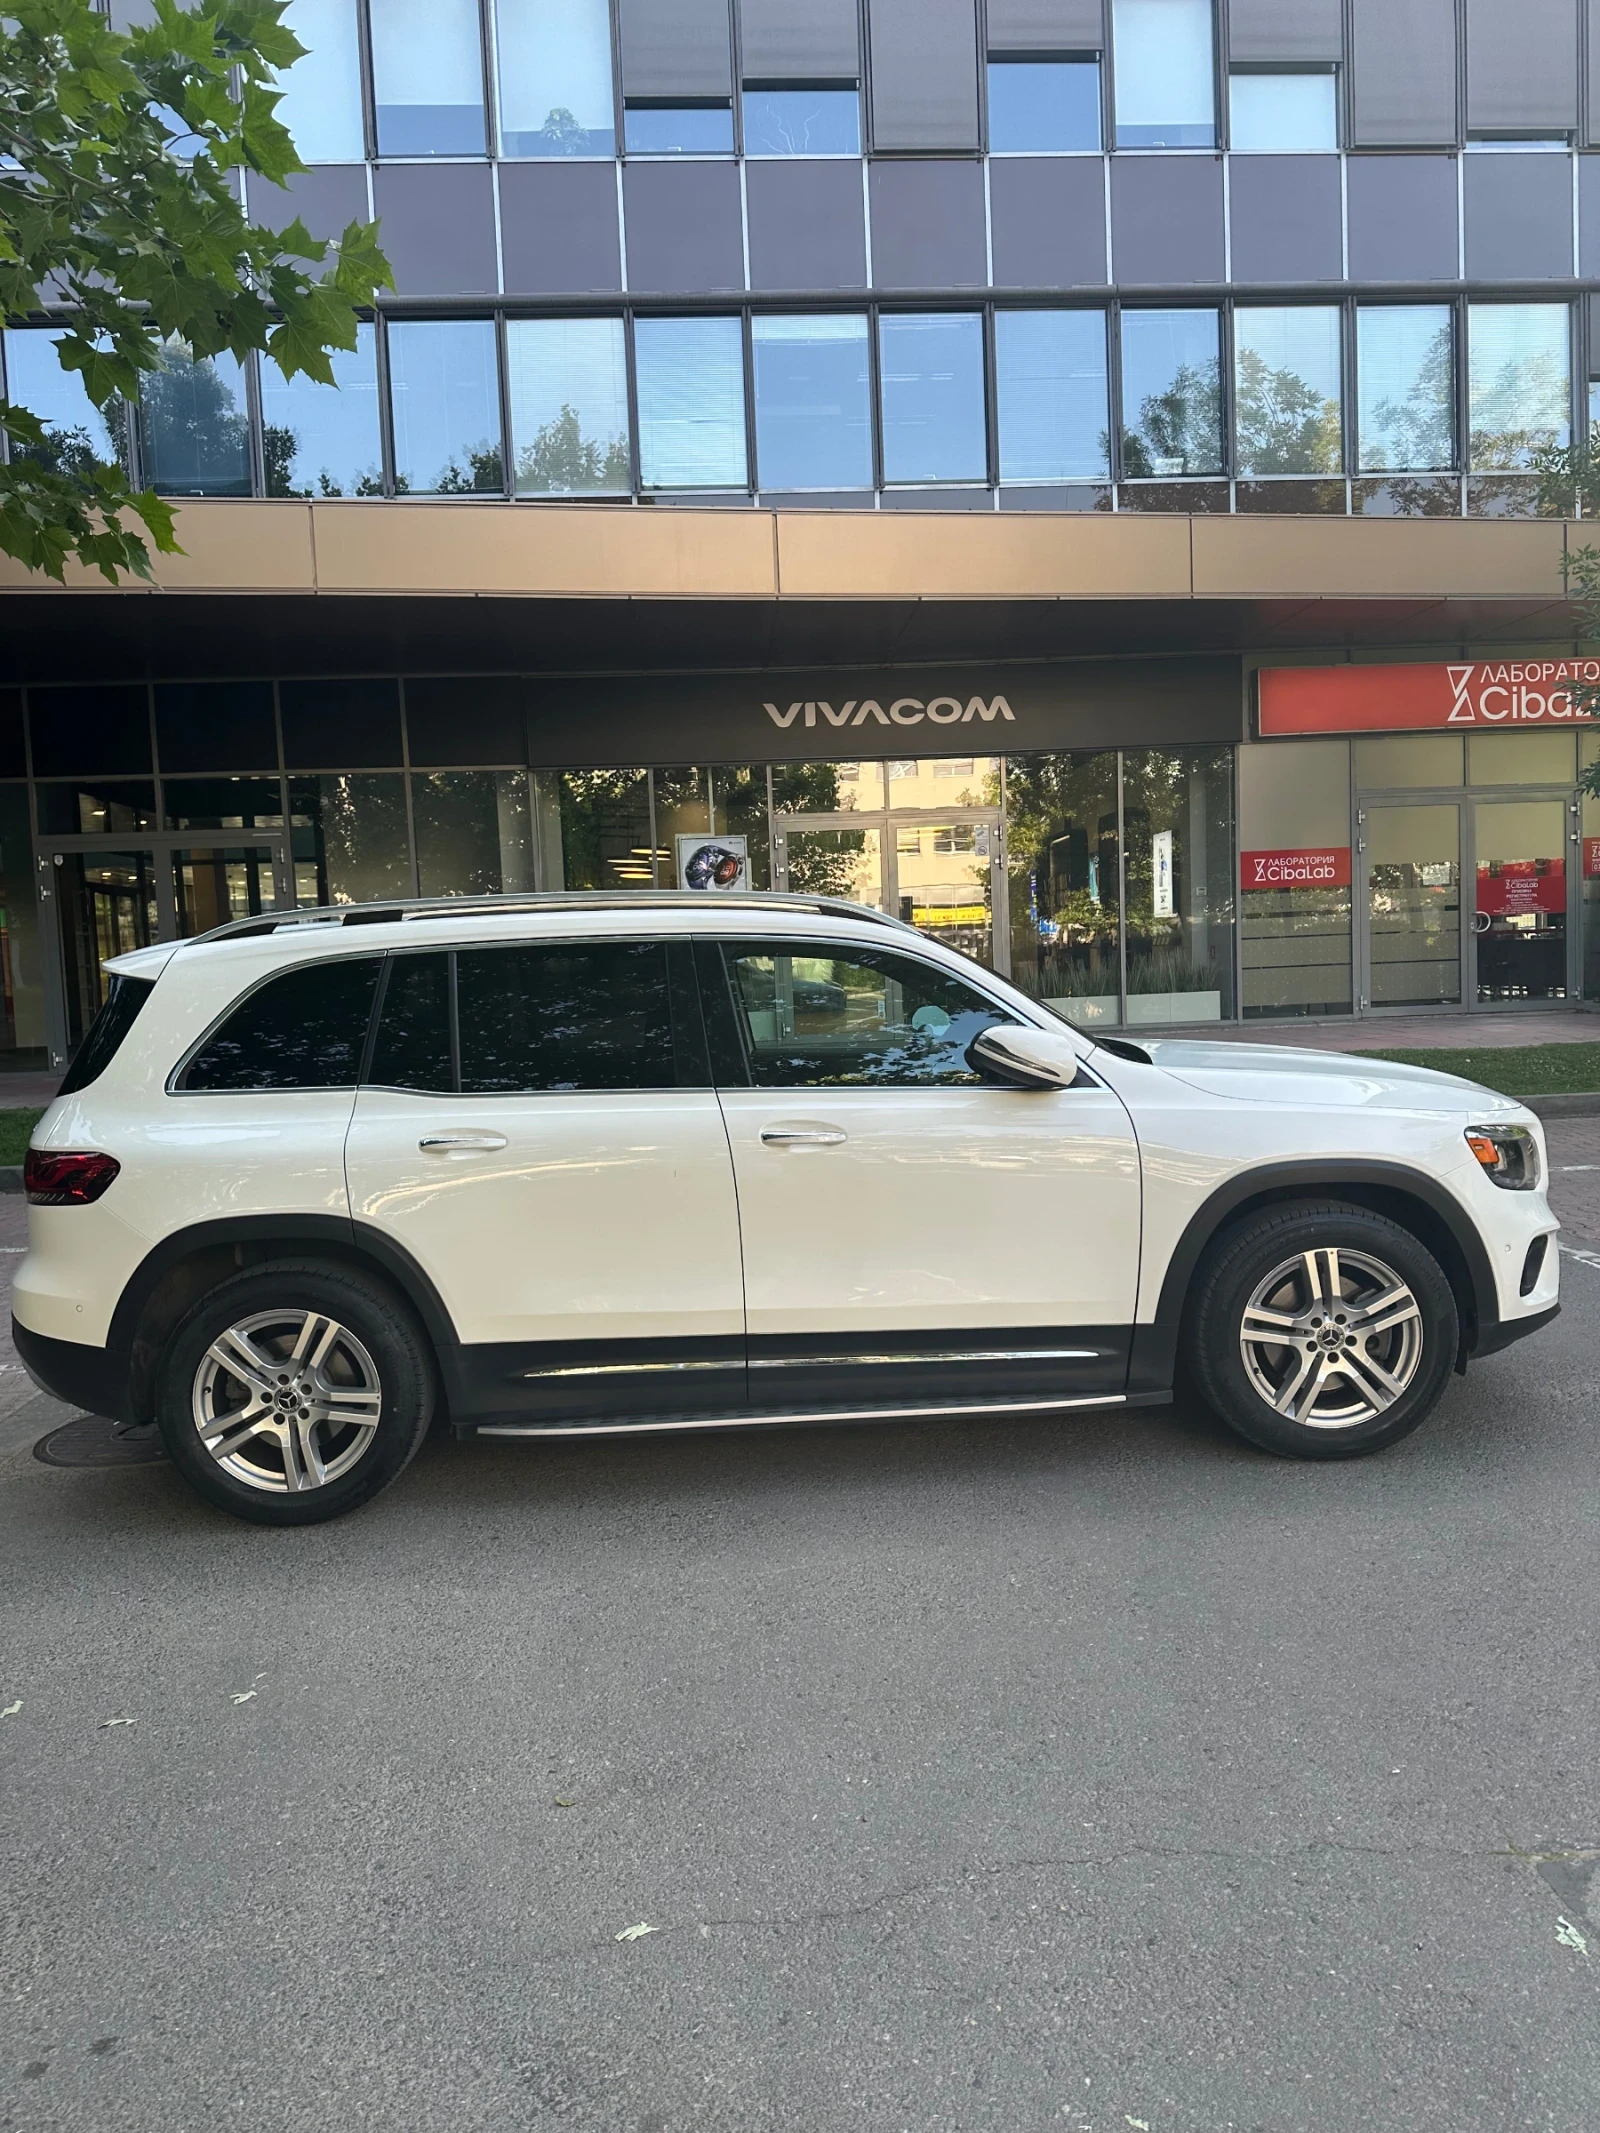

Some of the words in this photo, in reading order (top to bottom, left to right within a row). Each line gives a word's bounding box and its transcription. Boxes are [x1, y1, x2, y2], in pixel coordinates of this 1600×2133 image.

[762, 695, 1016, 728] VIVACOM
[1267, 856, 1335, 866] ЛАБОРАТОРИЯ
[1267, 865, 1335, 881] CibaLab
